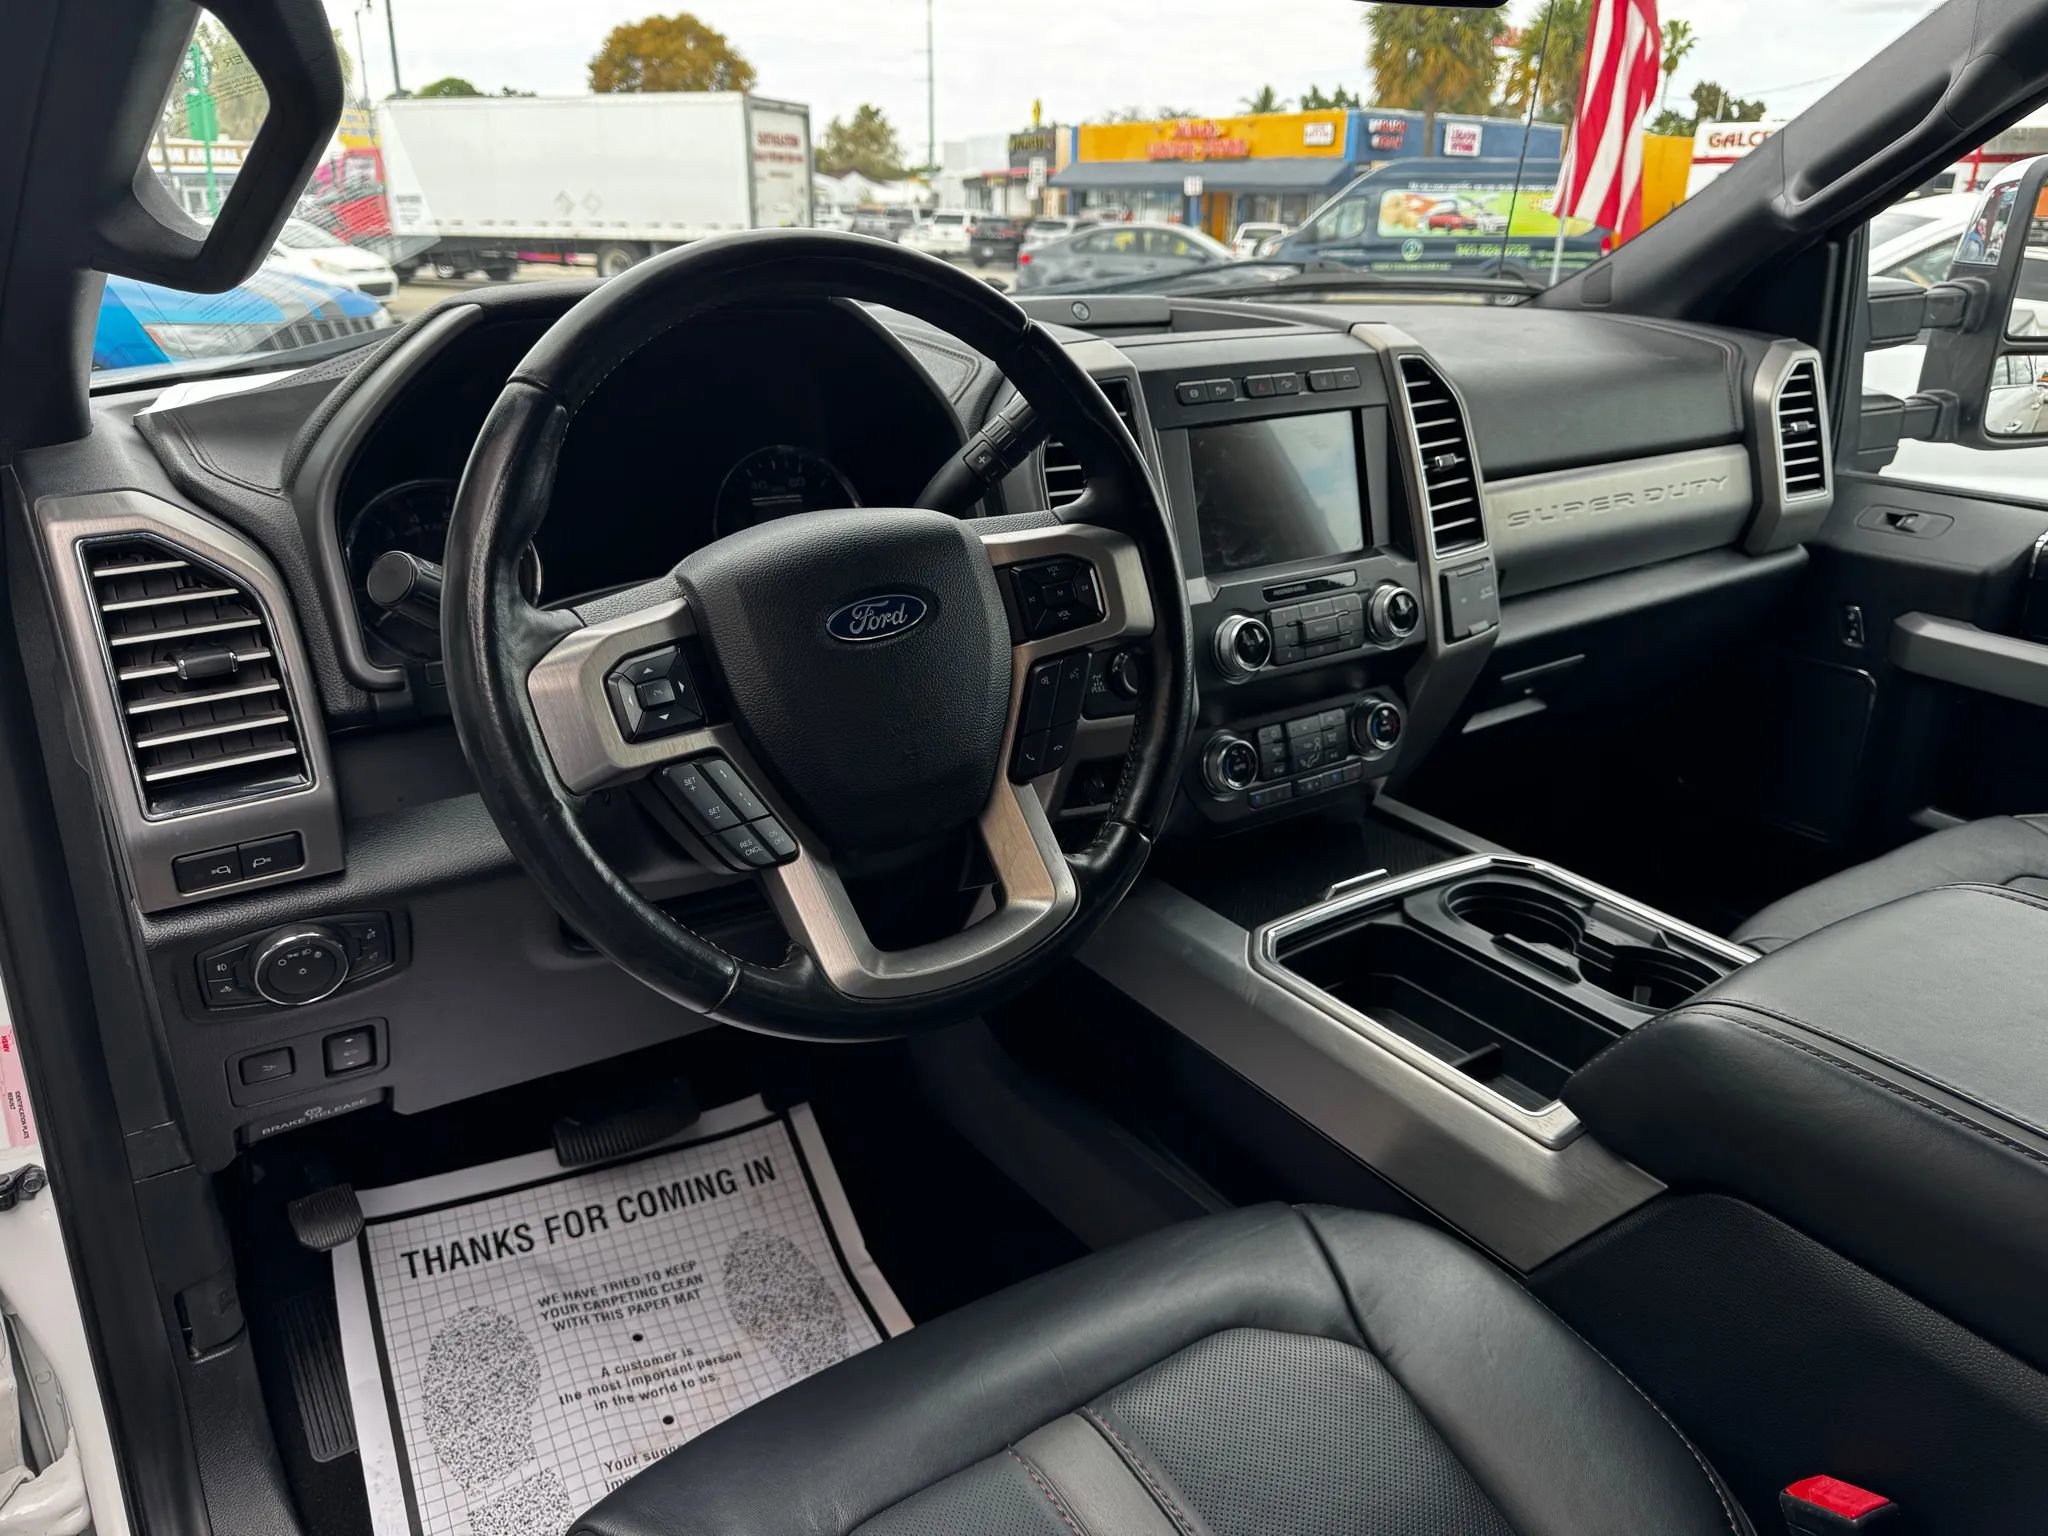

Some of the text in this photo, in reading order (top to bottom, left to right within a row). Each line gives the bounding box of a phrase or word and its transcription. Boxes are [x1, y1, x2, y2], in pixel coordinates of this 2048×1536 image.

[1507, 475, 1728, 527] SUPER DUTY
[849, 600, 908, 635] Ford
[684, 777, 696, 786] SET
[708, 806, 720, 816] SET
[740, 839, 753, 849] RES
[745, 845, 763, 856] CNCL
[262, 1097, 368, 1136] BRAKE RELEASE
[401, 1155, 777, 1279] THANKS FOR COMING IN
[538, 1260, 697, 1308] WE HAVE TRIED TO KEEP
[541, 1273, 704, 1321] YOUR CARPETING CLEAN
[552, 1288, 702, 1332] WITH THIS PAPER MAT
[559, 1391, 583, 1406] the
[587, 1380, 622, 1397] most
[696, 1350, 743, 1371] person
[601, 1366, 611, 1378] A
[614, 1350, 678, 1375] customer
[594, 1397, 608, 1411] in
[612, 1393, 635, 1407] the
[638, 1380, 678, 1401] world
[681, 1379, 696, 1390] to
[603, 1454, 638, 1473] Your
